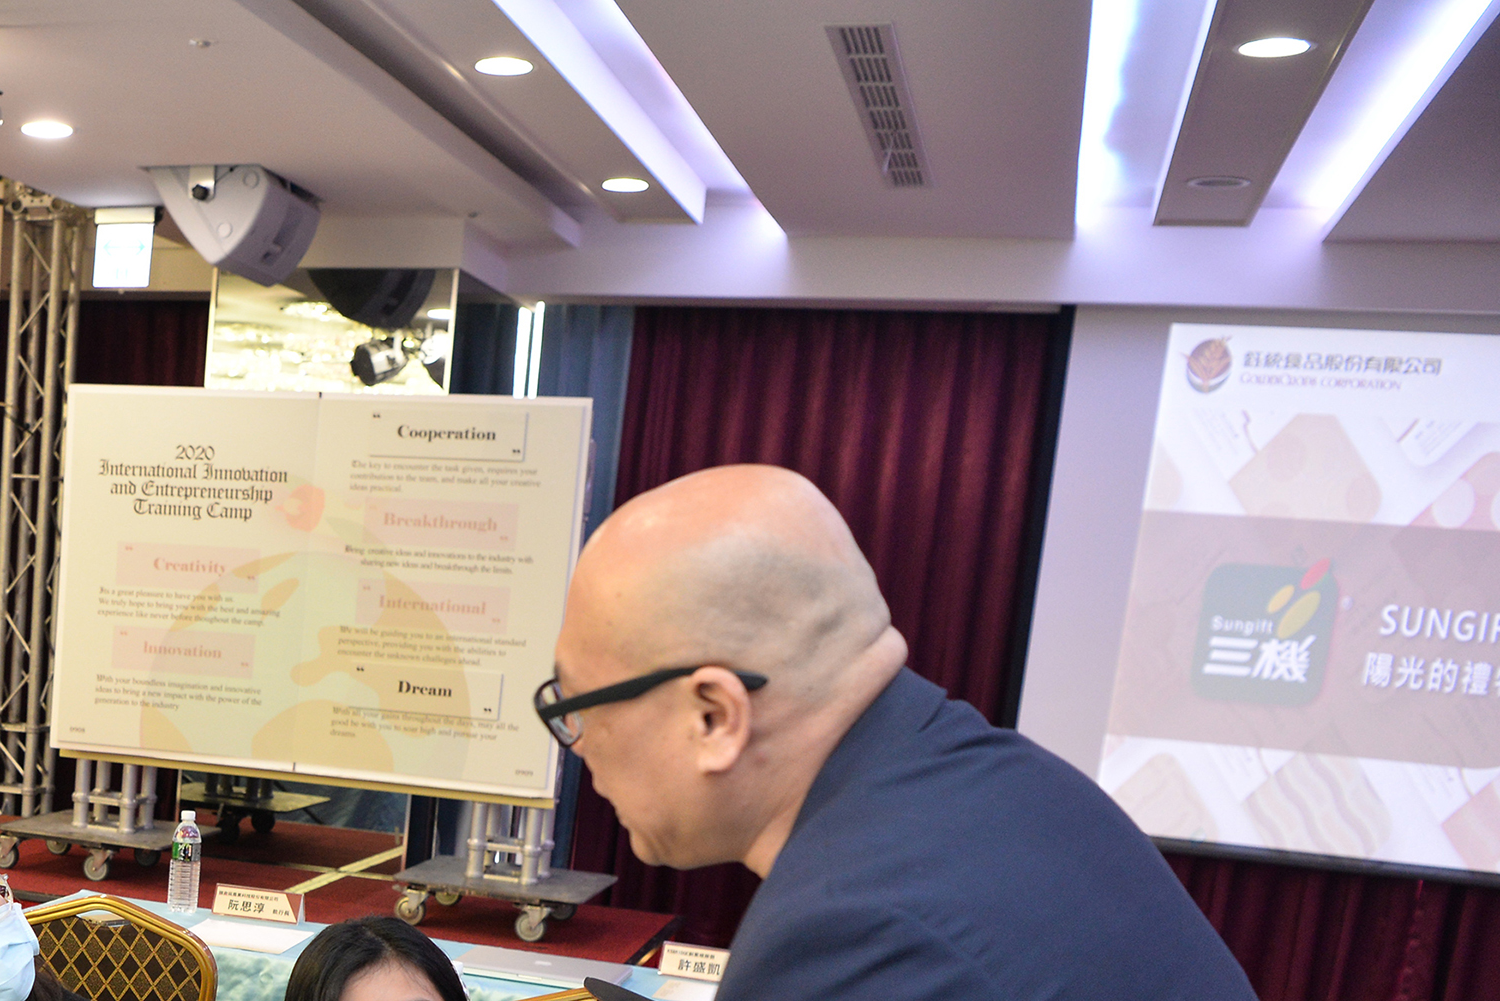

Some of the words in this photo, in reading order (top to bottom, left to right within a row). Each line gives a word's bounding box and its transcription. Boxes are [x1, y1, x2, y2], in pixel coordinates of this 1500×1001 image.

[397, 425, 496, 442] Cooperation
[175, 444, 215, 460] 2020
[98, 459, 197, 479] International
[202, 463, 288, 483] Innovation
[110, 481, 136, 495] and
[141, 480, 273, 504] Entrepreneurship
[134, 499, 202, 520] Training
[207, 502, 252, 522] Camp
[384, 512, 497, 532] Breakthrough
[153, 557, 225, 577] Creativity
[379, 595, 486, 615] International
[1211, 615, 1273, 635] Sungift
[143, 641, 222, 659] Innovation
[1203, 634, 1316, 683] 三機
[1363, 652, 1500, 696] 陽光的禮
[398, 680, 452, 697] Dream
[228, 899, 265, 913] 阮思淳
